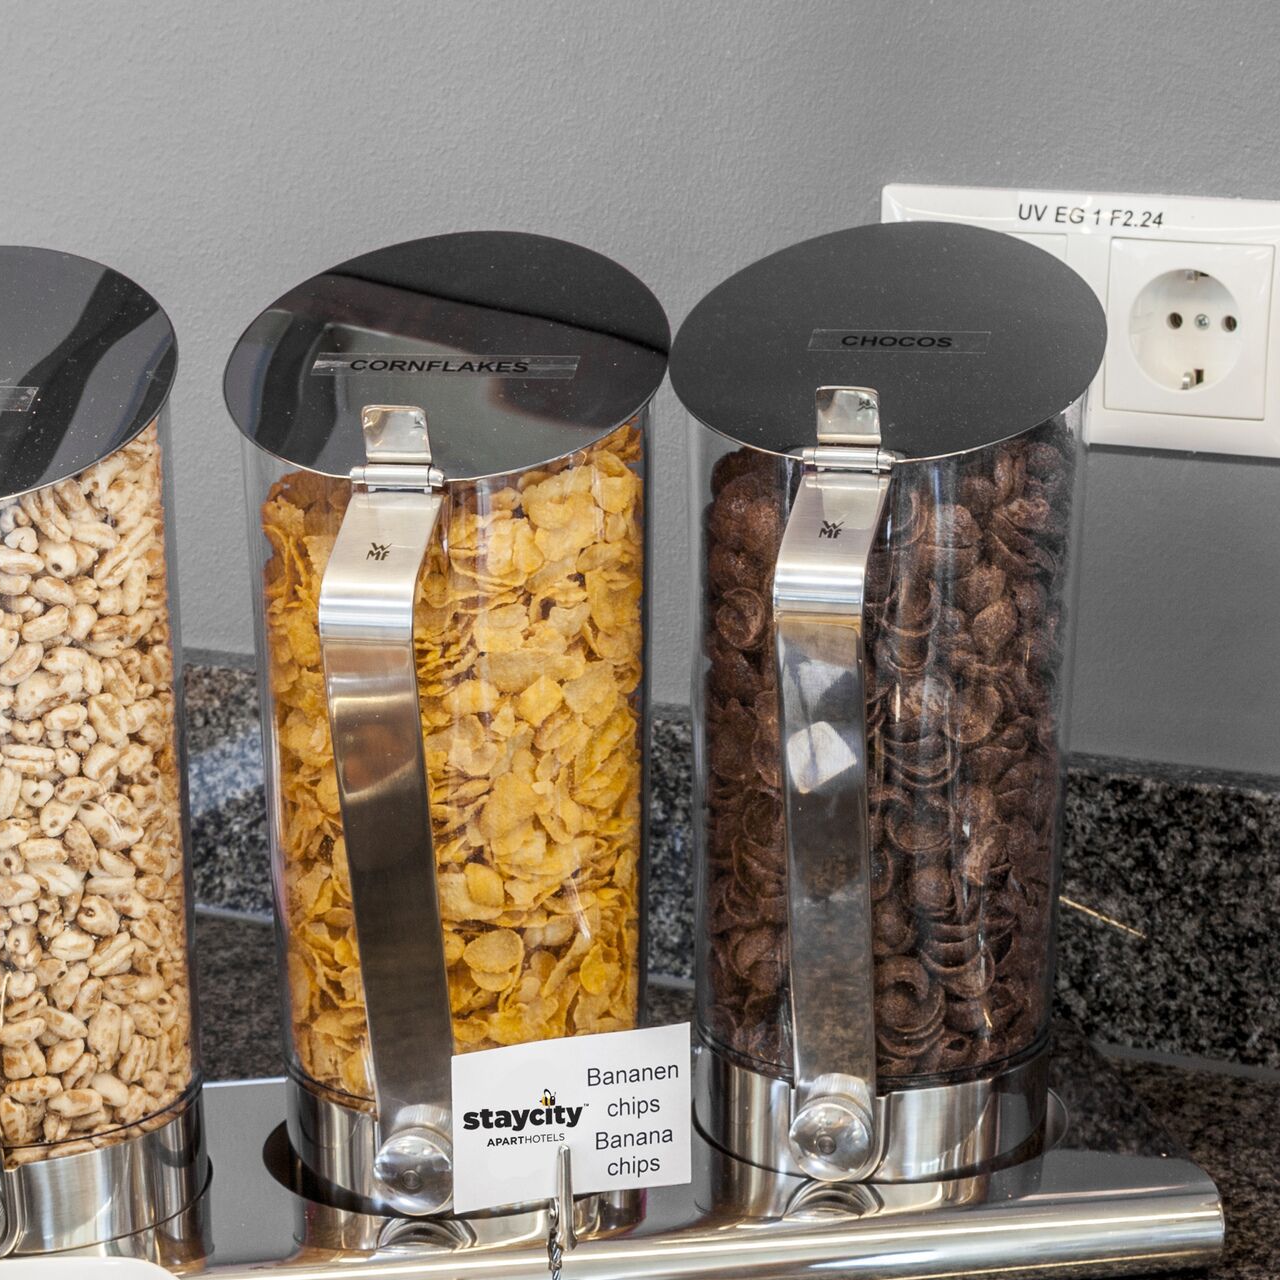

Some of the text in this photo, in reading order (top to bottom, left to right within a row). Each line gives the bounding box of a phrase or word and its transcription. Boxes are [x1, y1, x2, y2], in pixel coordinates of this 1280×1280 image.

[1018, 204, 1165, 229] UV EG 1 F2.24
[841, 335, 953, 348] CHOCOS
[350, 360, 529, 373] CORNFLAKES
[587, 1064, 679, 1087] Bananen
[607, 1097, 661, 1119] chips
[487, 1132, 565, 1148] APARTHOTELS
[595, 1127, 673, 1150] Banana
[607, 1156, 661, 1177] chips
